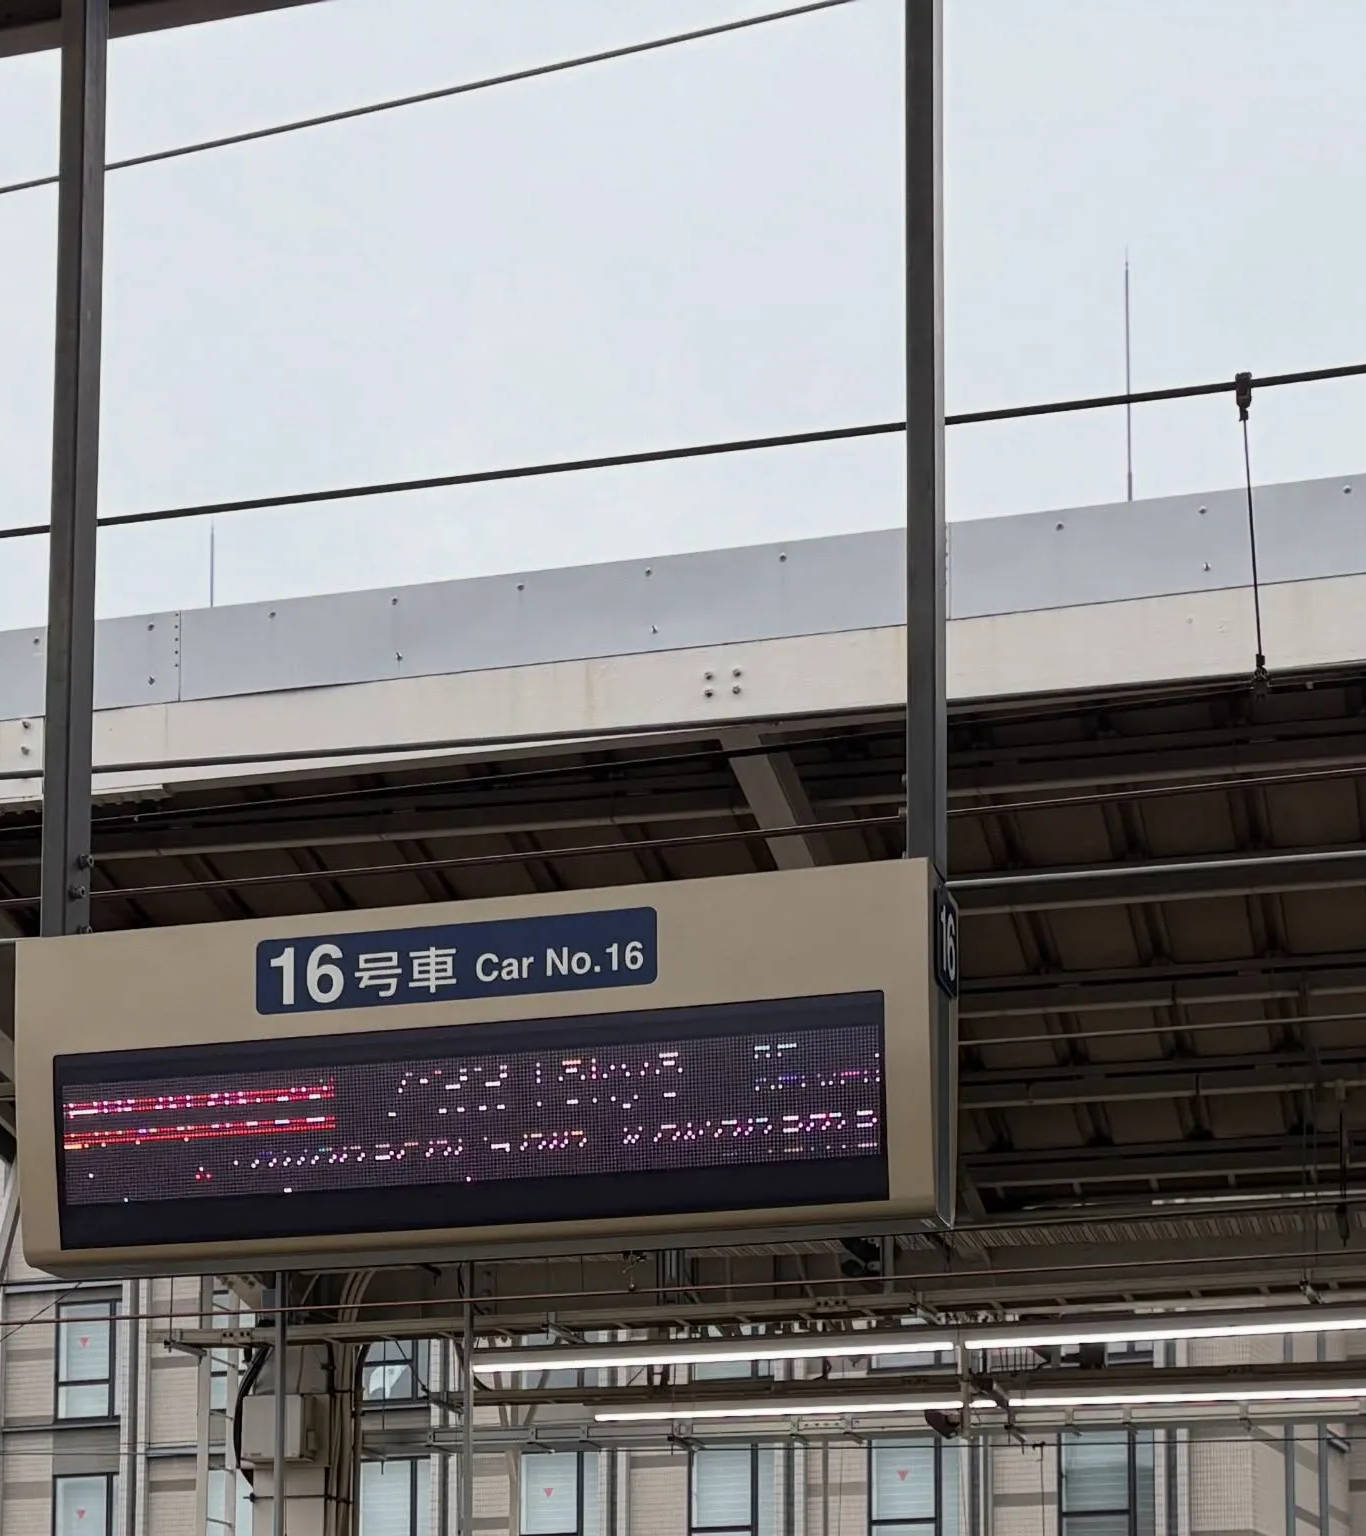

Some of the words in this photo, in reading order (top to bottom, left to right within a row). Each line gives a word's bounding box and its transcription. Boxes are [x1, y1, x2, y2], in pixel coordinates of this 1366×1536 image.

[269, 943, 458, 1006] 16号車
[475, 952, 534, 982] Car
[545, 941, 645, 977] No.16
[940, 904, 956, 982] 16
